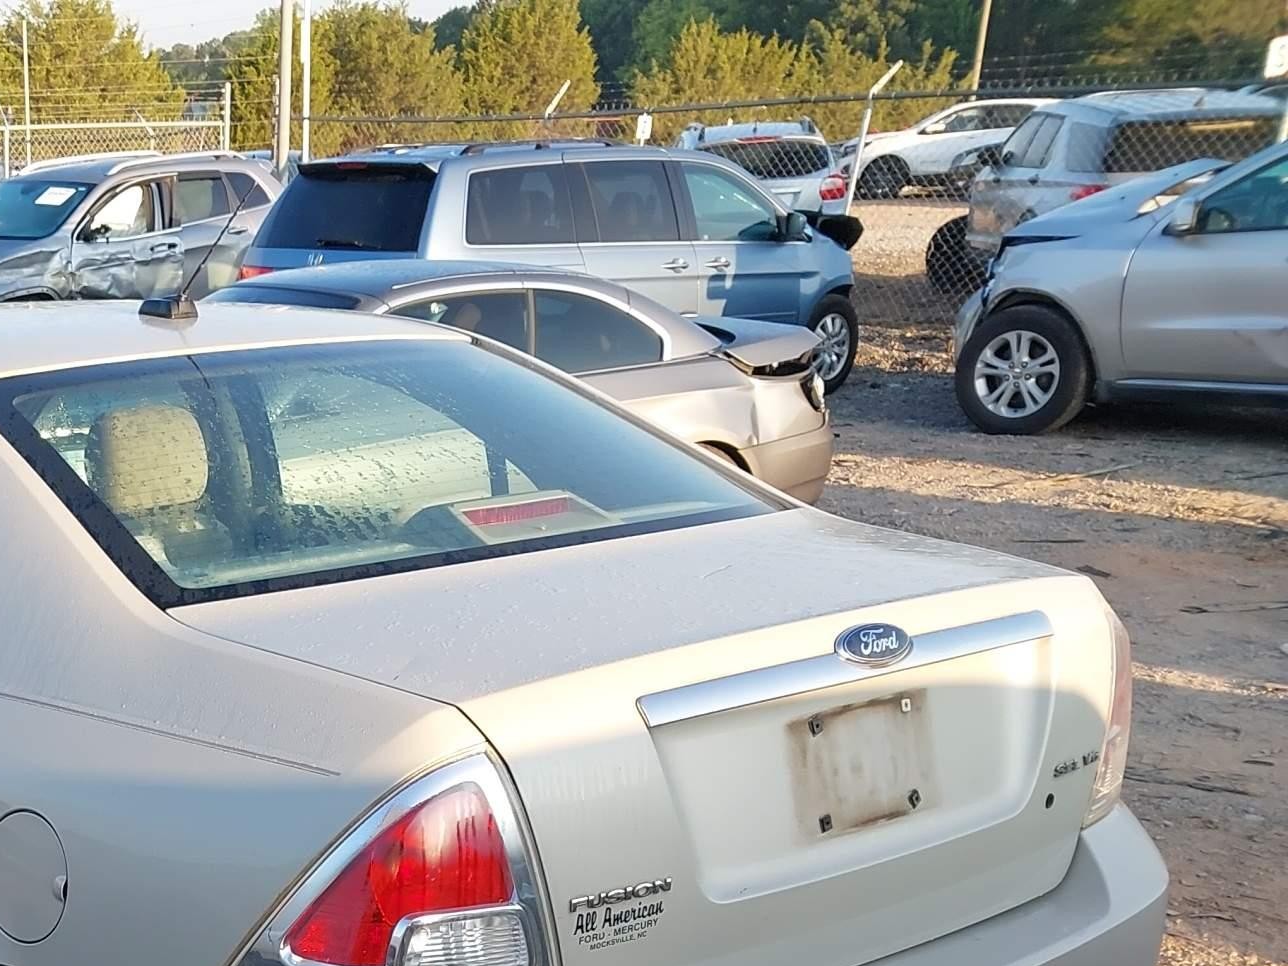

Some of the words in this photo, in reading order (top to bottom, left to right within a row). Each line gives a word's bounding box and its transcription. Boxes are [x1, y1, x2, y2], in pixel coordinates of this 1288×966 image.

[859, 628, 899, 656] Ford
[569, 877, 673, 913] FUSION
[574, 910, 598, 936] All
[602, 901, 665, 929] American
[578, 931, 606, 945] FORD
[613, 918, 659, 937] MERCURY
[637, 930, 648, 939] NC
